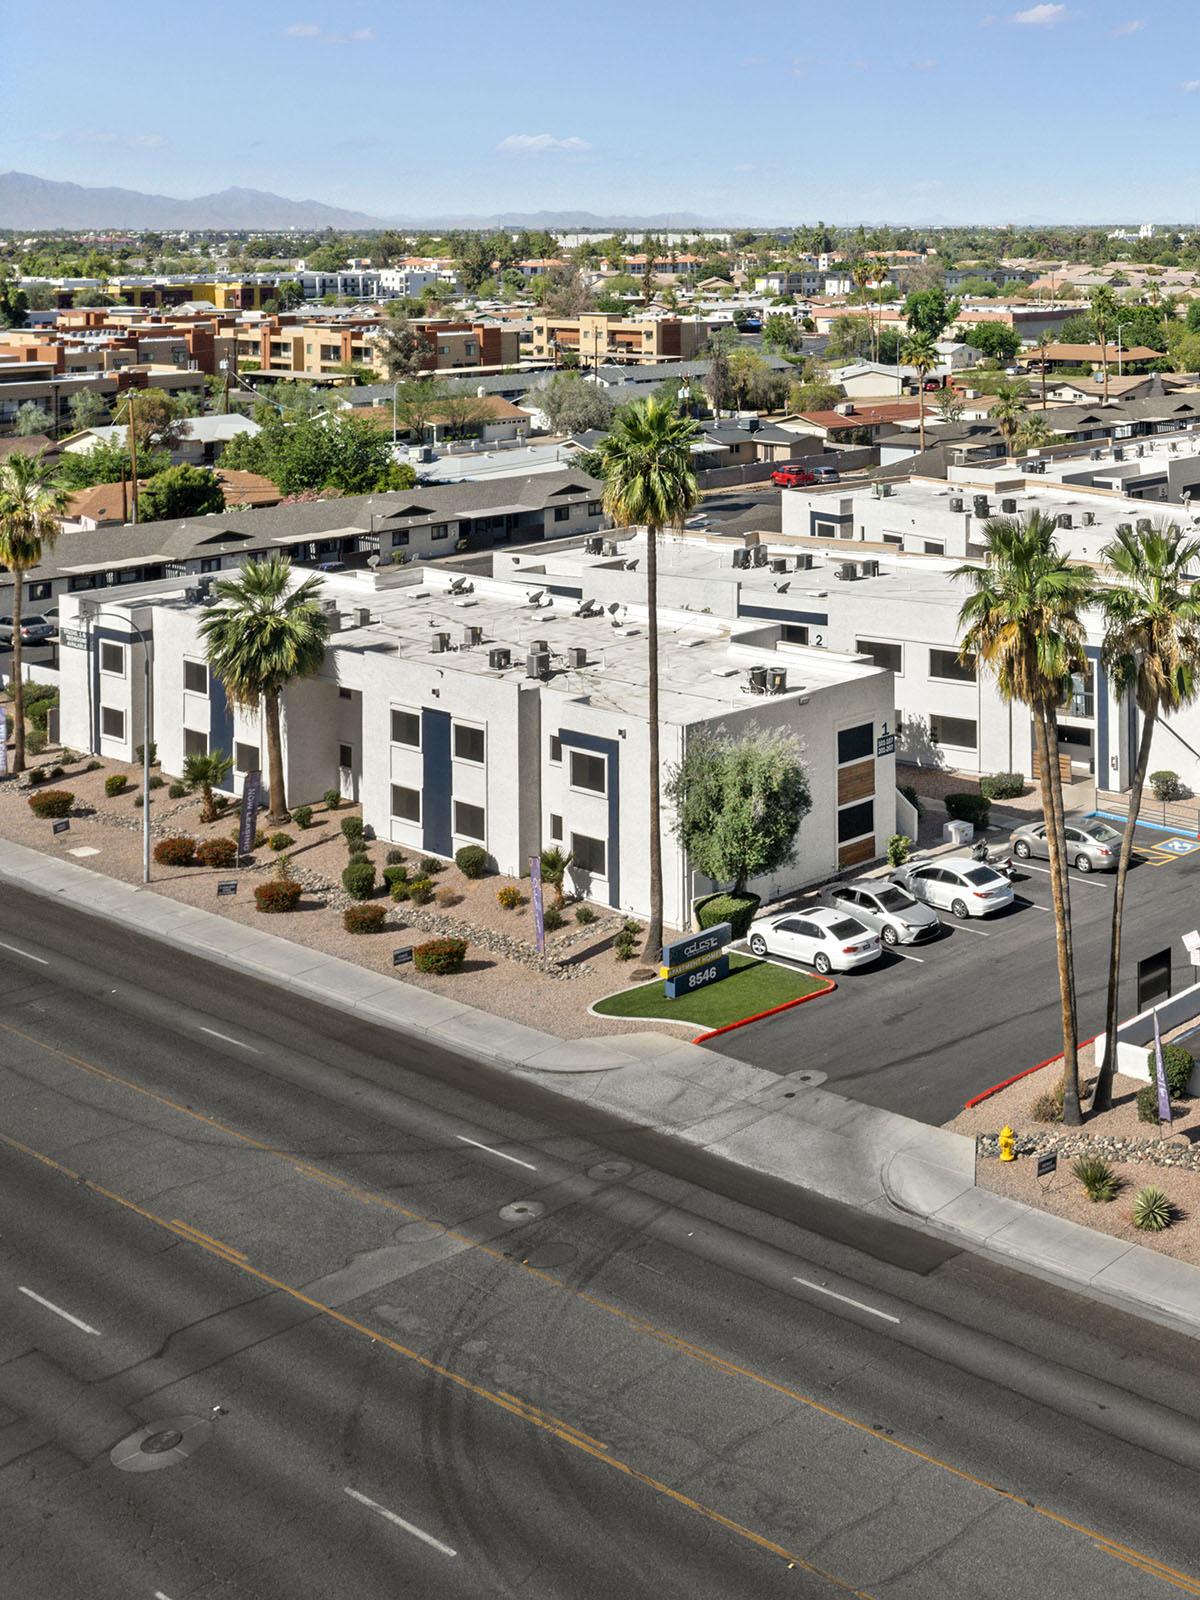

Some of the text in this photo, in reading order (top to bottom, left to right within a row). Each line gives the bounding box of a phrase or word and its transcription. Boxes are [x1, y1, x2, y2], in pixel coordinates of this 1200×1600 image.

[816, 634, 823, 646] 2
[881, 722, 889, 736] 1
[246, 788, 256, 809] NOW
[688, 966, 717, 987] 8546
